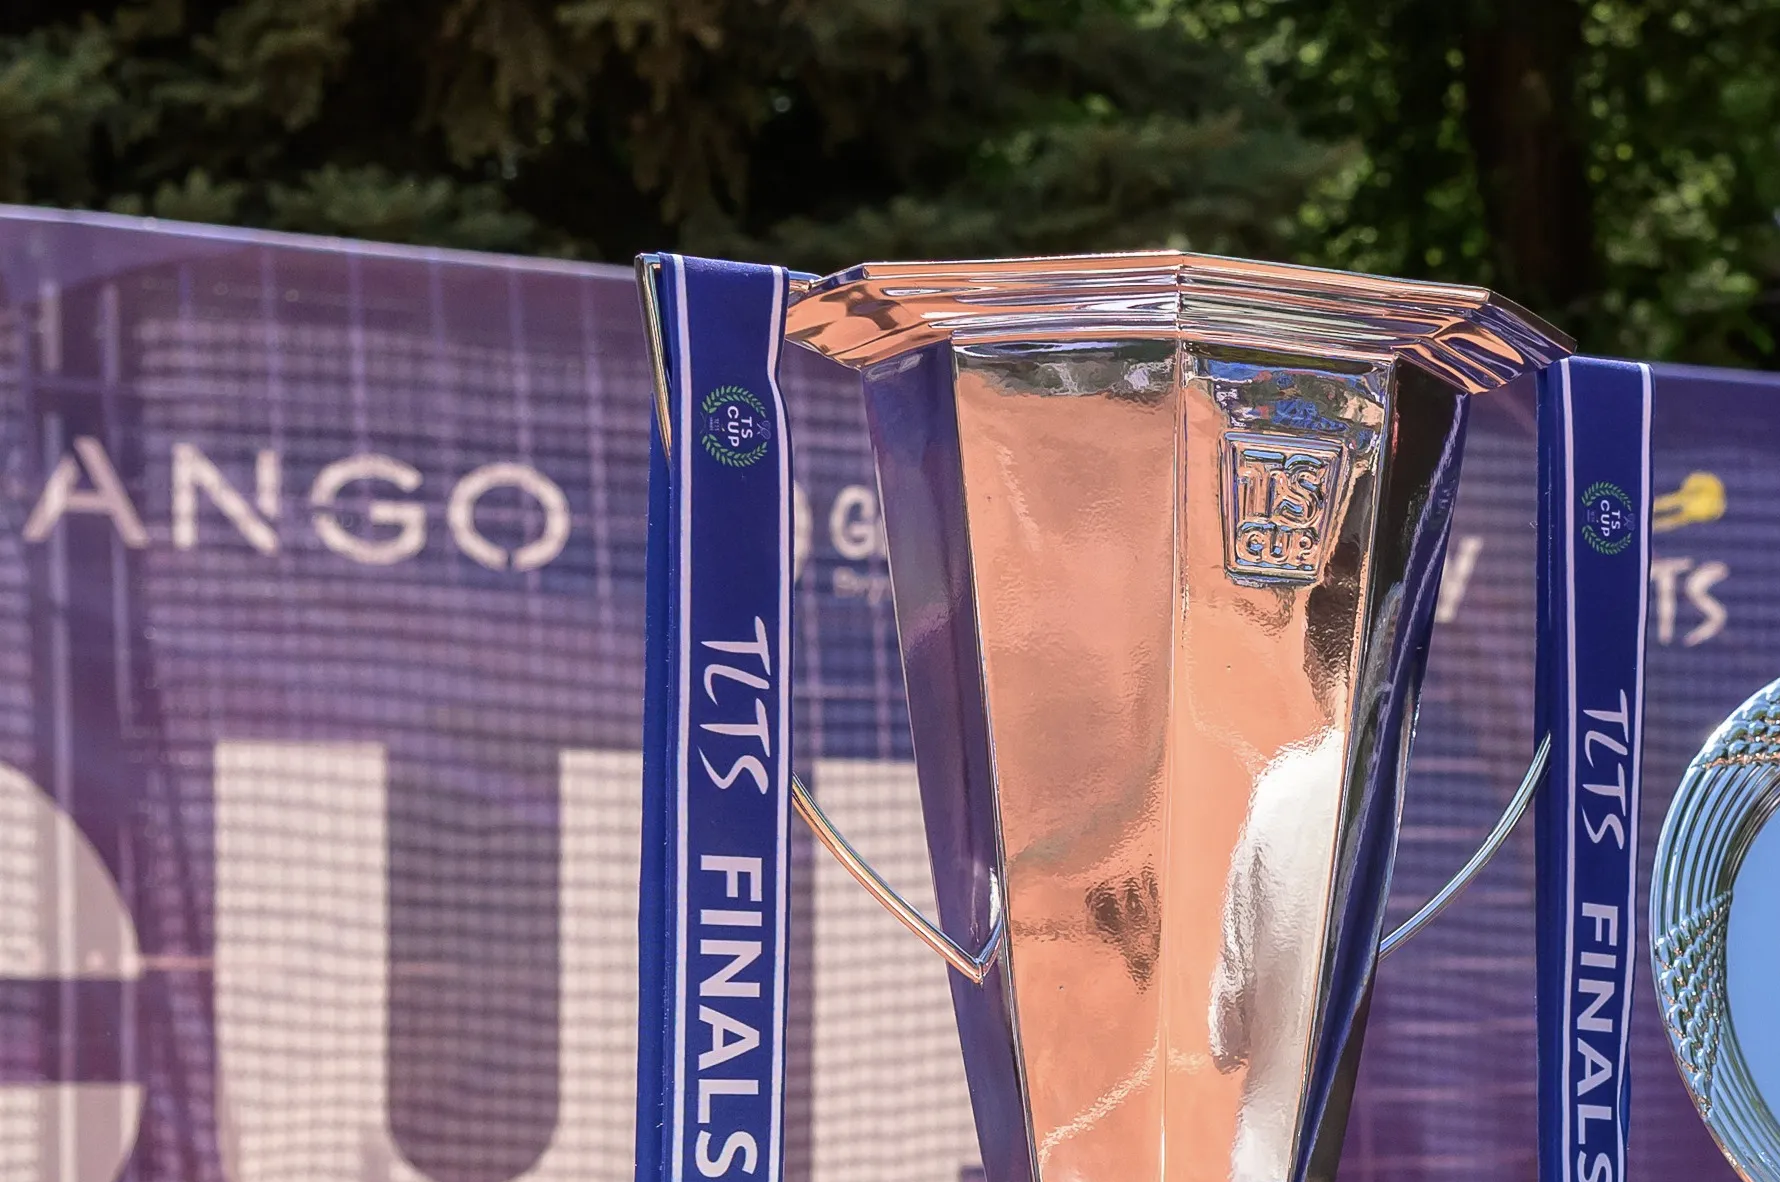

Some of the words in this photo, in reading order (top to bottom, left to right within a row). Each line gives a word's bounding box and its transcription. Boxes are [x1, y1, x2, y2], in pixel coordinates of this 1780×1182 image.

[727, 405, 739, 447] CUP
[741, 416, 753, 439] TS
[1239, 450, 1323, 523] TS
[1600, 500, 1610, 537] CUP
[1611, 509, 1621, 529] TS
[1650, 556, 1730, 646] TS
[697, 615, 771, 795] TLTS
[1581, 688, 1629, 850] TLTS
[694, 853, 763, 1178] FINALS
